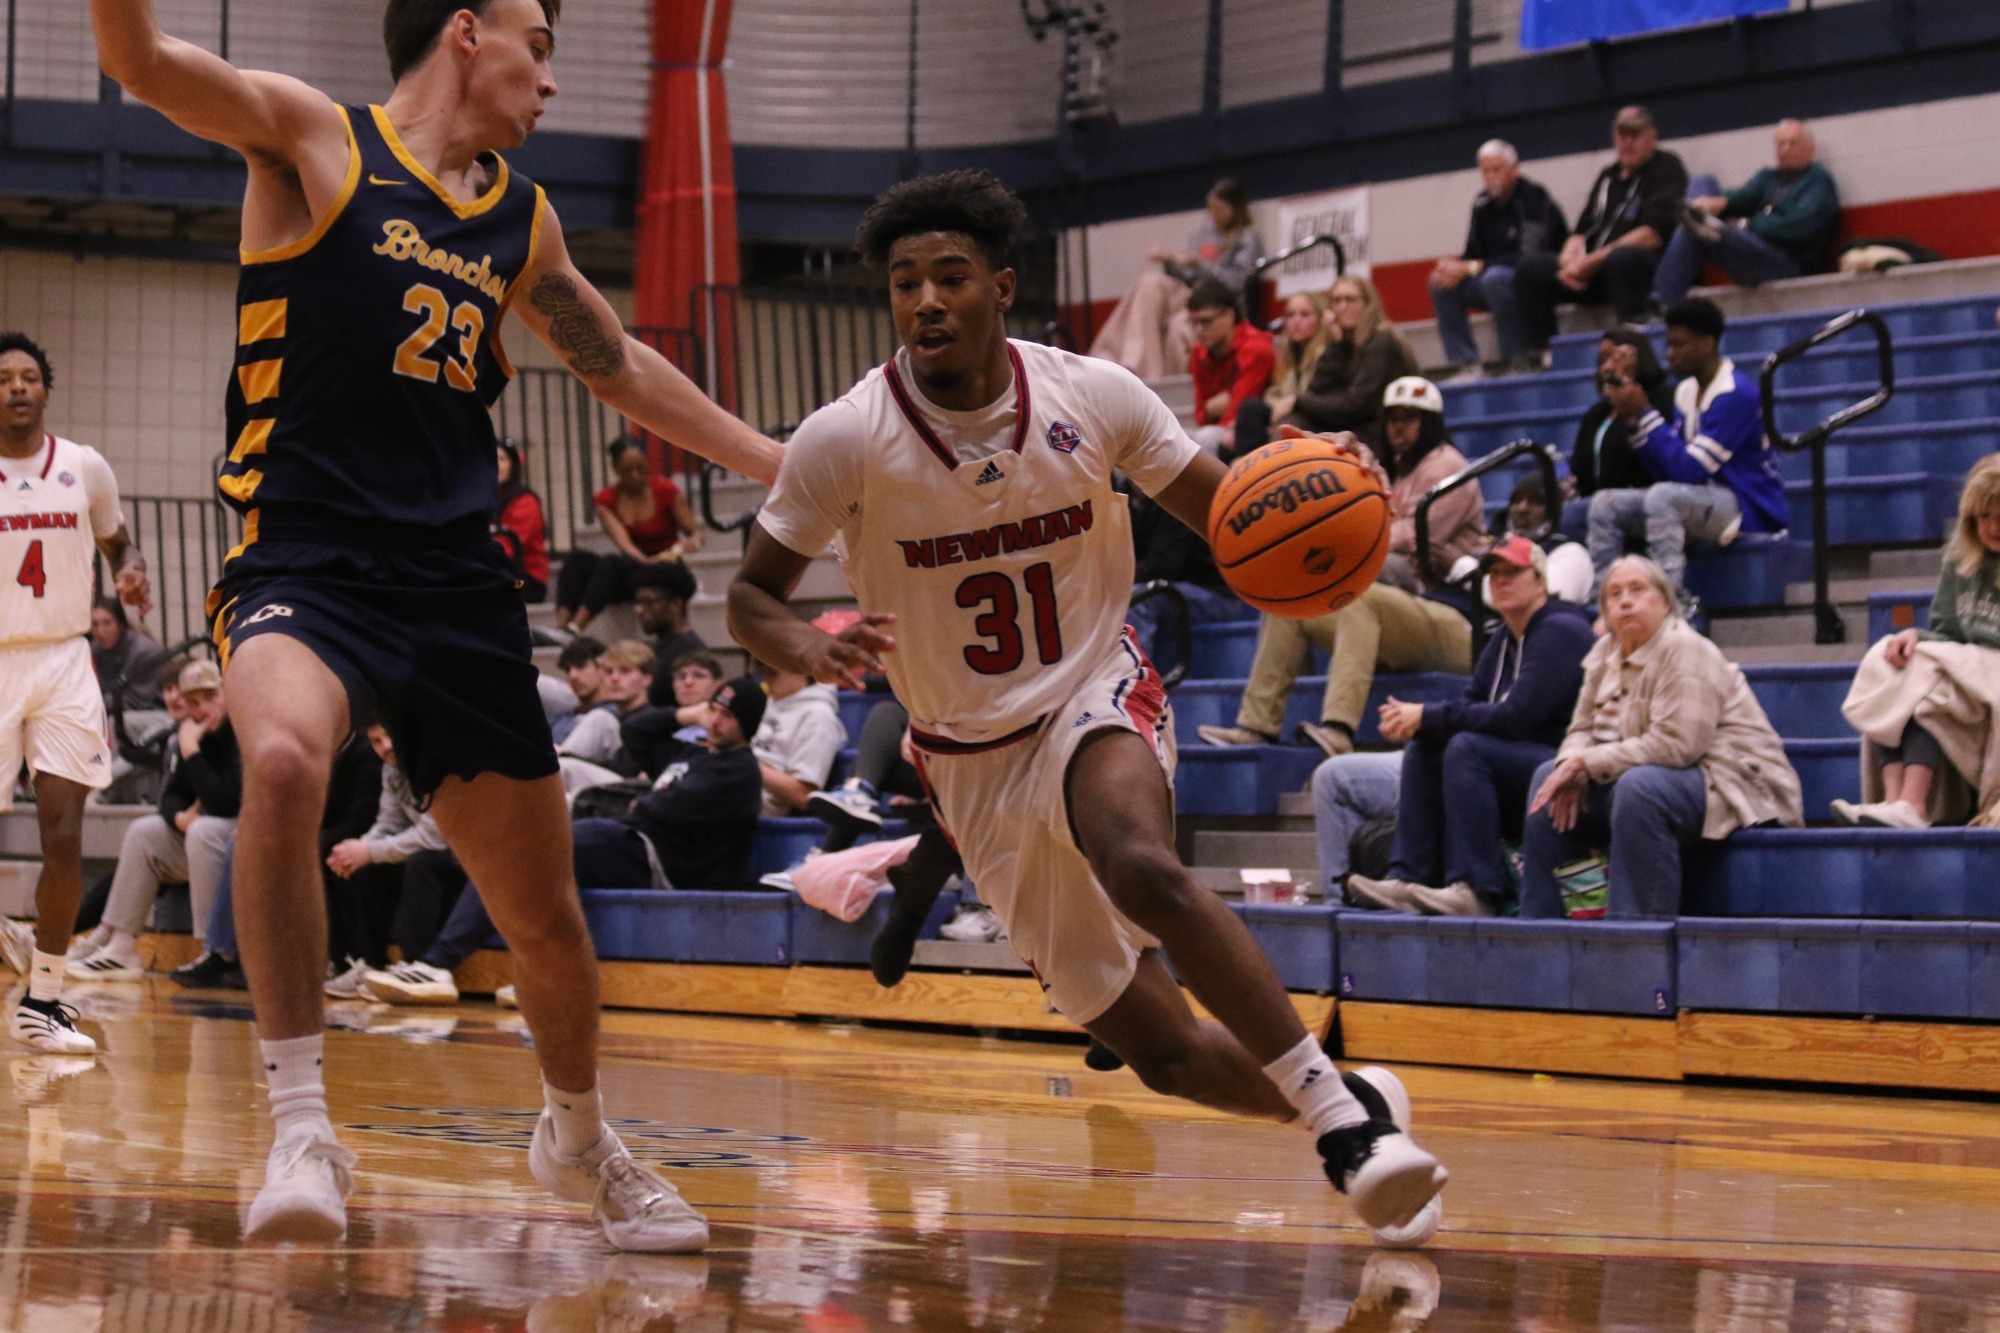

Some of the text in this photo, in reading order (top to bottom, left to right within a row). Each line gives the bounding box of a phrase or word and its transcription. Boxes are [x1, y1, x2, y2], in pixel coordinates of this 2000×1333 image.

[392, 282, 484, 392] 23
[0, 512, 78, 532] EWMAN
[894, 498, 1093, 568] NEWMAN
[1227, 468, 1347, 537] Wilson
[16, 539, 46, 598] 4
[955, 561, 1063, 675] 31
